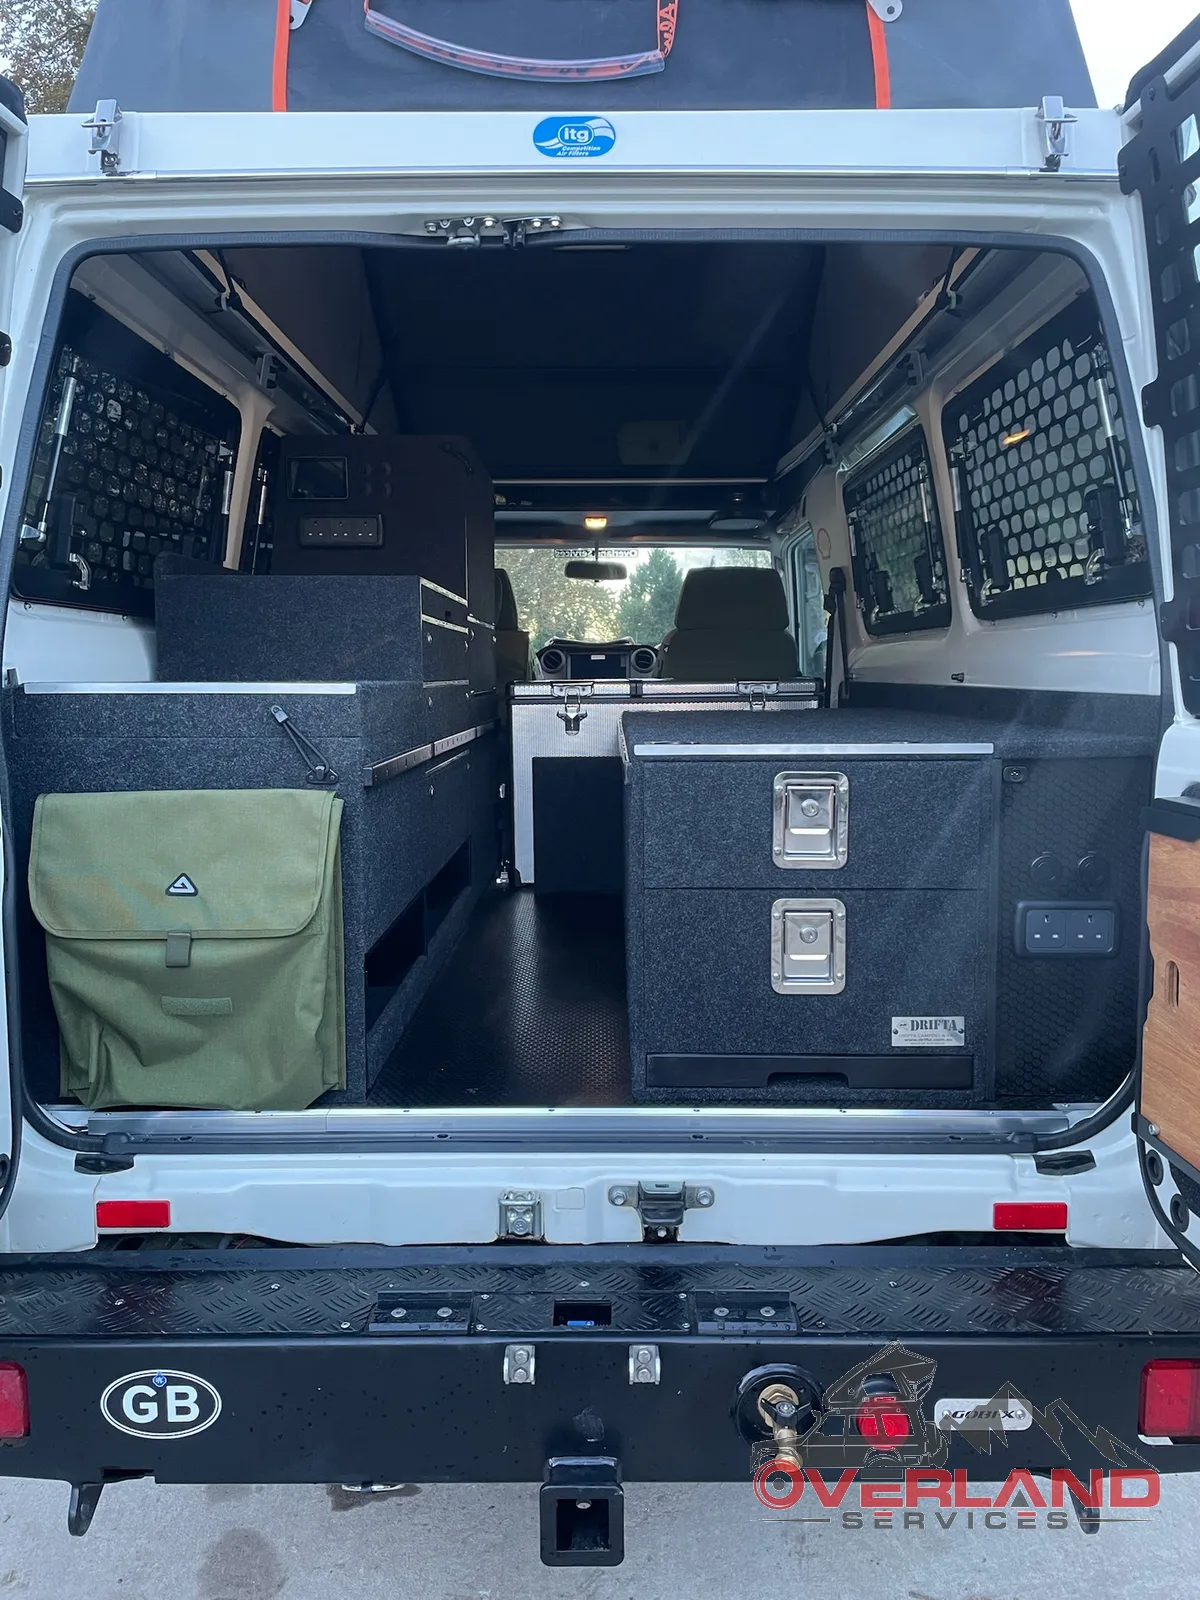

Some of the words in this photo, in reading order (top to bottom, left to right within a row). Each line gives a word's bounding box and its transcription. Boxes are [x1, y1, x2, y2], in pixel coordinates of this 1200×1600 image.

[564, 127, 589, 143] itg
[910, 1019, 958, 1031] DRIFTA
[122, 1385, 200, 1424] GB
